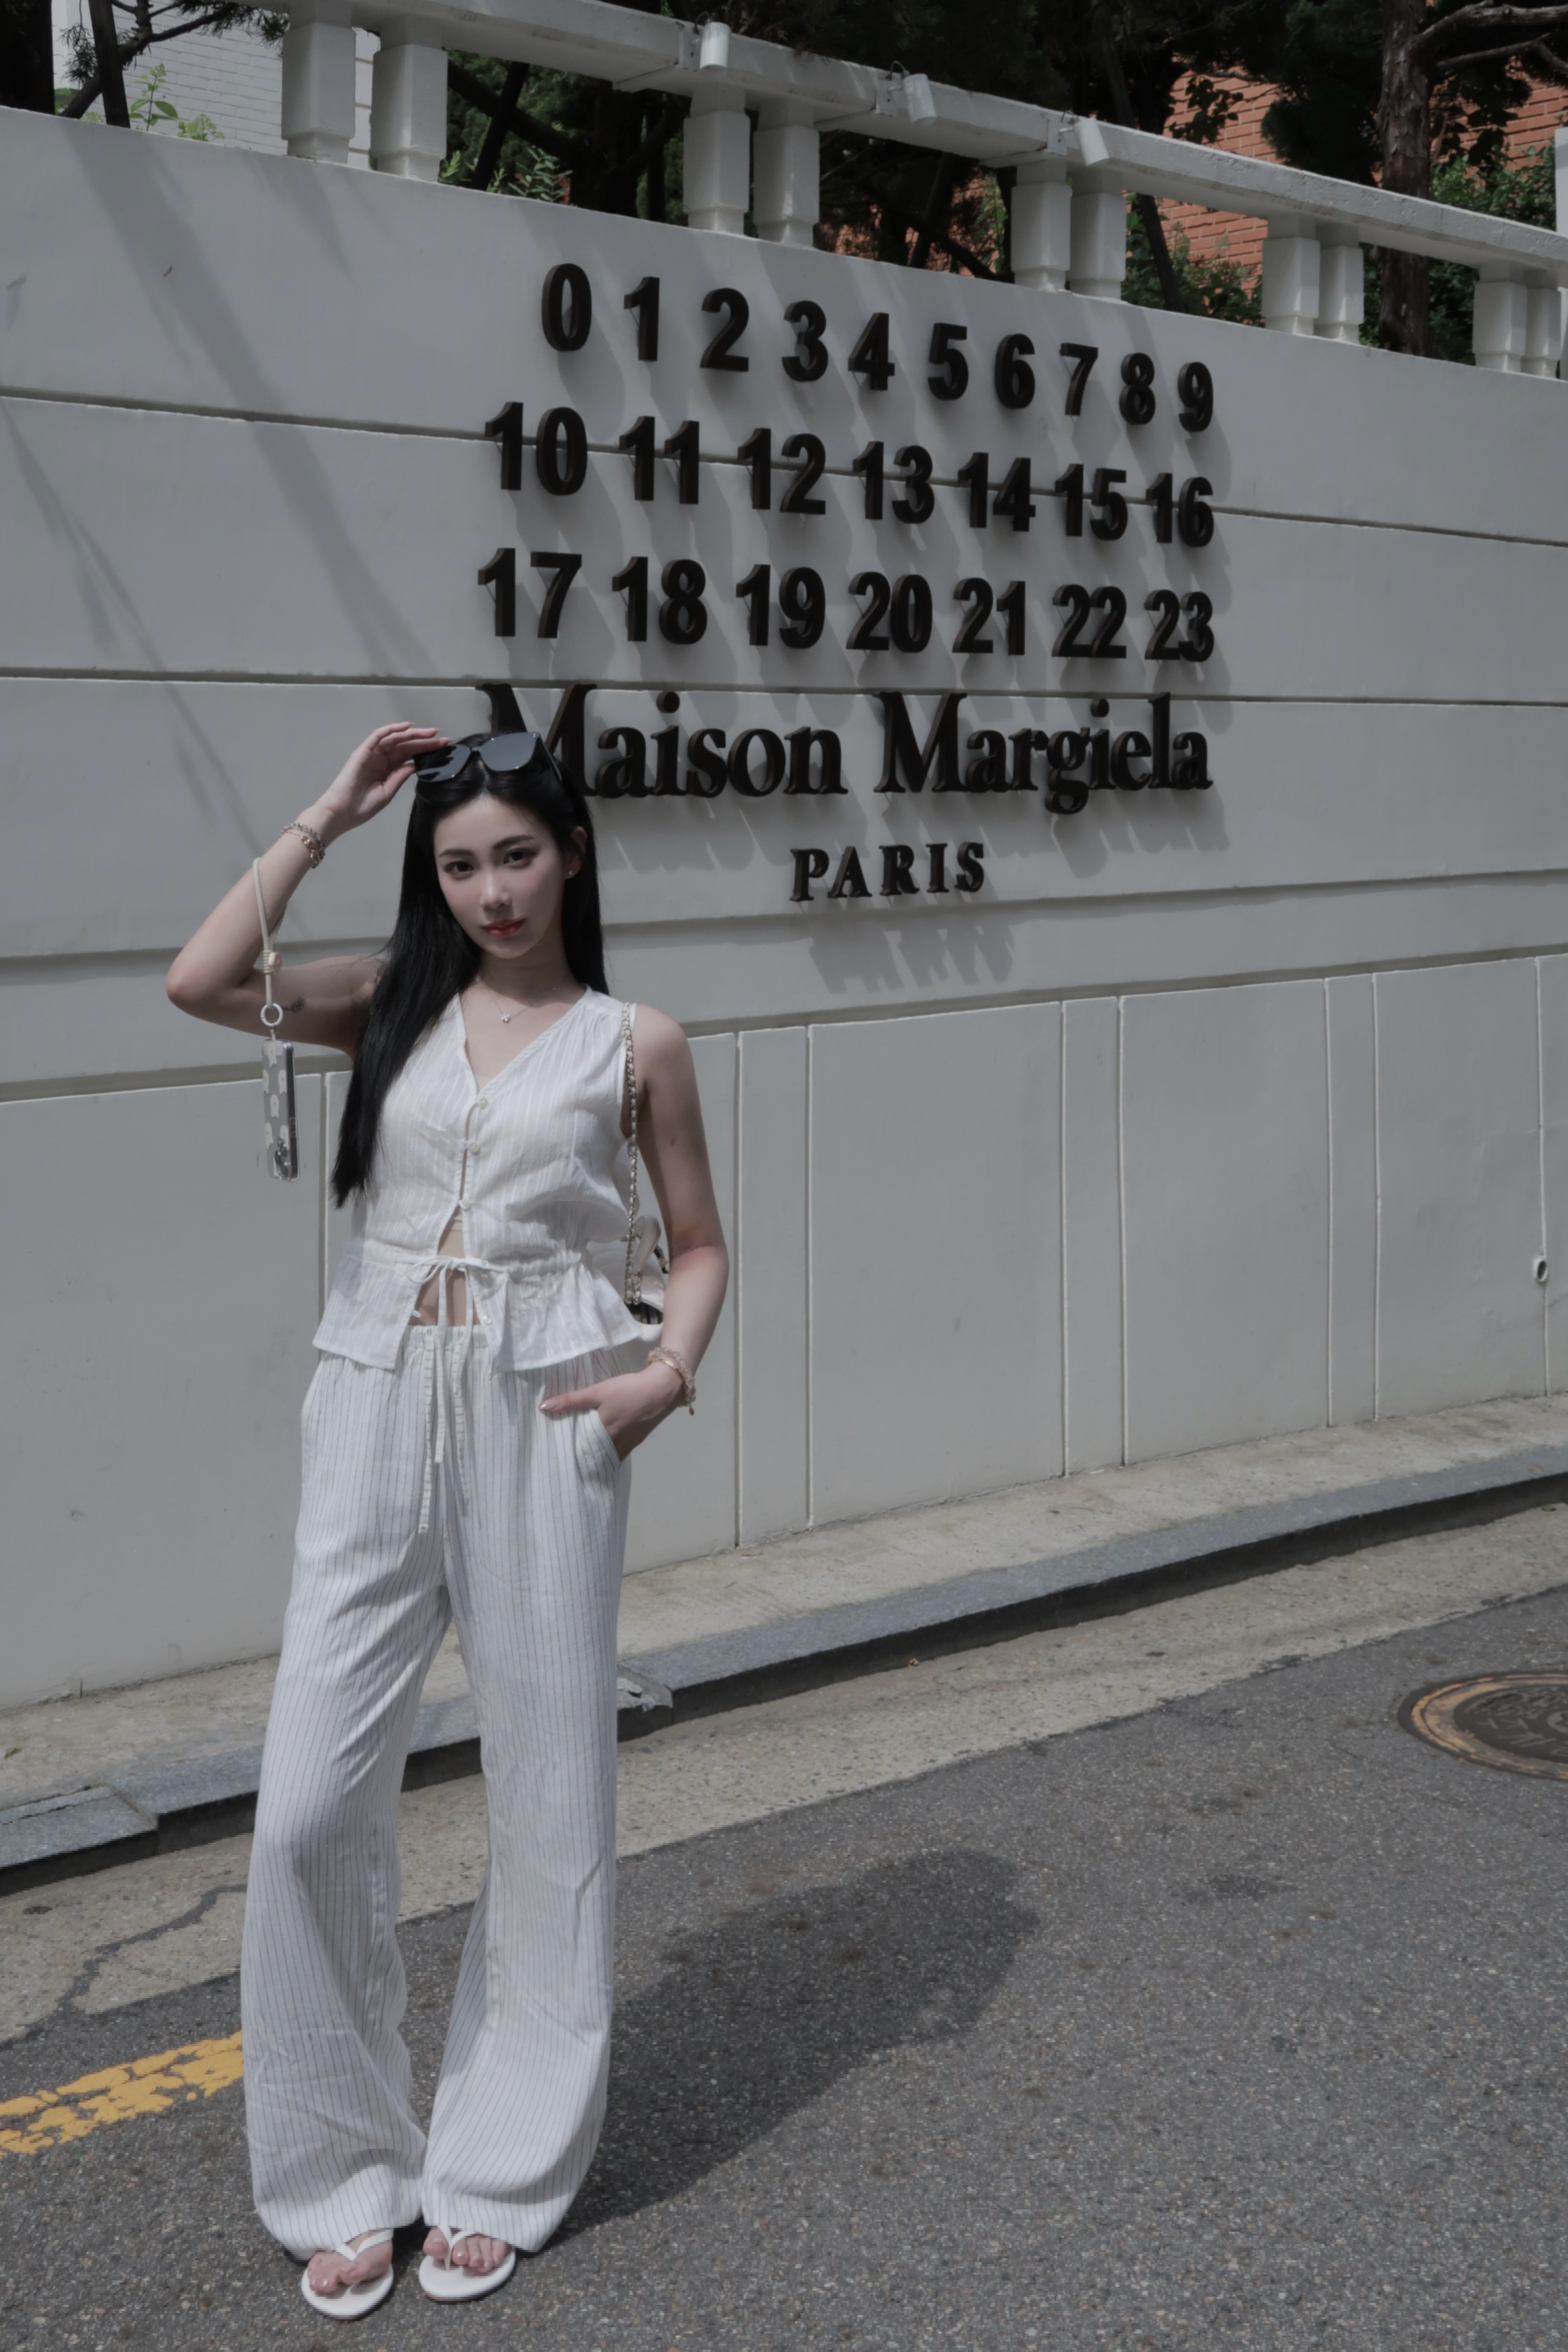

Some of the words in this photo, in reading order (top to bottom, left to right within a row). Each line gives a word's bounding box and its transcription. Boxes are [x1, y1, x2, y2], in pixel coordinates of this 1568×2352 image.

[542, 264, 592, 352] 0
[624, 277, 659, 361] 1
[700, 288, 748, 372] 2
[782, 301, 828, 382] 3
[848, 313, 895, 391] 4
[928, 323, 968, 401] 5
[994, 334, 1035, 409] 6
[1060, 343, 1098, 416] 7
[1119, 353, 1156, 425] 8
[1178, 362, 1213, 433] 9
[485, 402, 588, 495] 10
[619, 416, 700, 504] 11
[738, 428, 826, 515] 12
[853, 442, 935, 524] 13
[958, 452, 1036, 532] 14
[1055, 464, 1128, 541] 15
[1145, 473, 1214, 547] 16
[478, 548, 582, 638] 17
[612, 557, 707, 645] 18
[736, 565, 825, 649] 19
[847, 572, 932, 653] 20
[952, 578, 1025, 655] 21
[1052, 585, 1126, 659] 22
[1144, 590, 1214, 662] 23
[872, 691, 1214, 814] Margiela
[790, 842, 985, 902] PARIS
